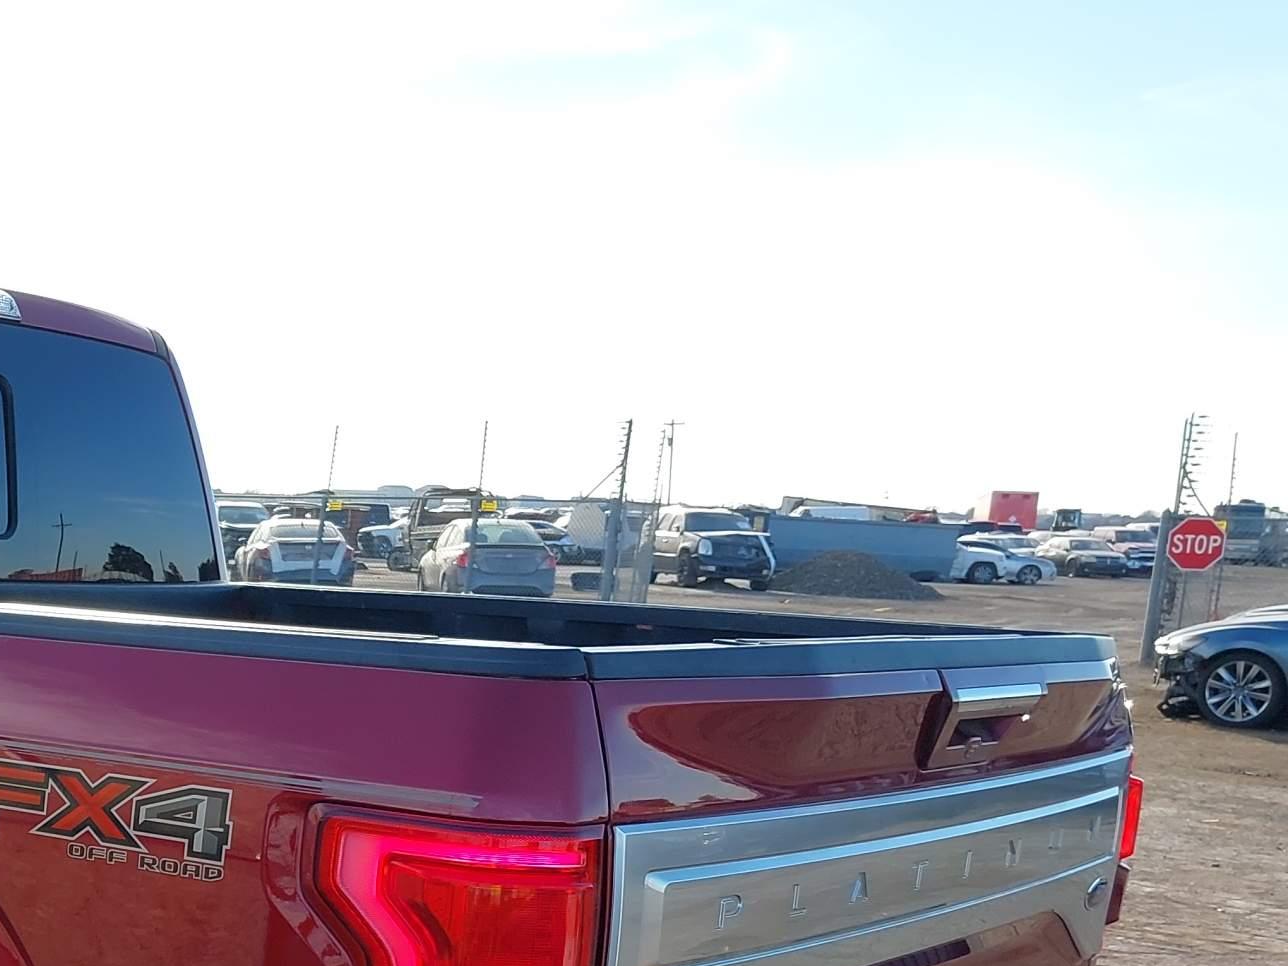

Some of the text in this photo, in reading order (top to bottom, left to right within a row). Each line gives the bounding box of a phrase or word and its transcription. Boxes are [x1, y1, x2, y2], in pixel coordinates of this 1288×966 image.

[1171, 534, 1222, 554] STOP
[67, 843, 225, 881] OFF ROAD
[714, 815, 1102, 930] PLATINUM
